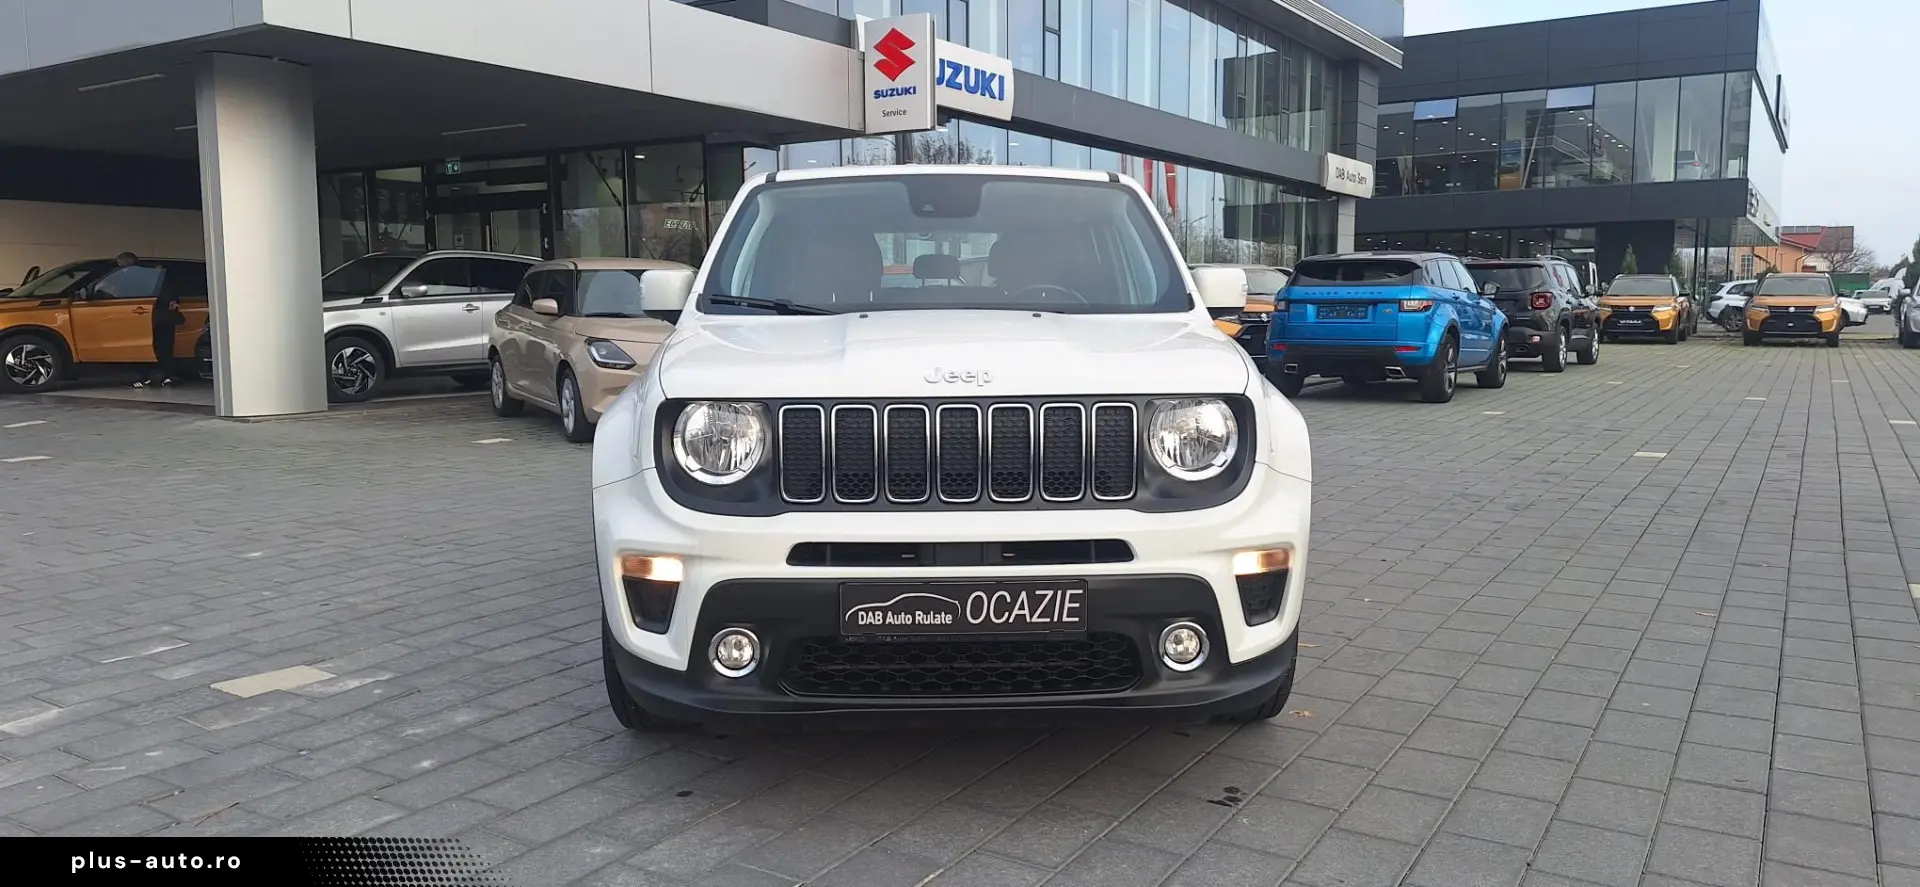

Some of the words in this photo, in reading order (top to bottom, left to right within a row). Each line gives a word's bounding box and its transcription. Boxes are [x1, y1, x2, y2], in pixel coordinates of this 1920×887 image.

[873, 85, 917, 100] SUZUKI
[882, 108, 907, 118] Service
[924, 366, 995, 388] Jeep
[965, 589, 1084, 624] OCAZIE
[858, 610, 883, 625] DAB
[885, 610, 913, 625] Auto
[915, 611, 953, 625] Rulate
